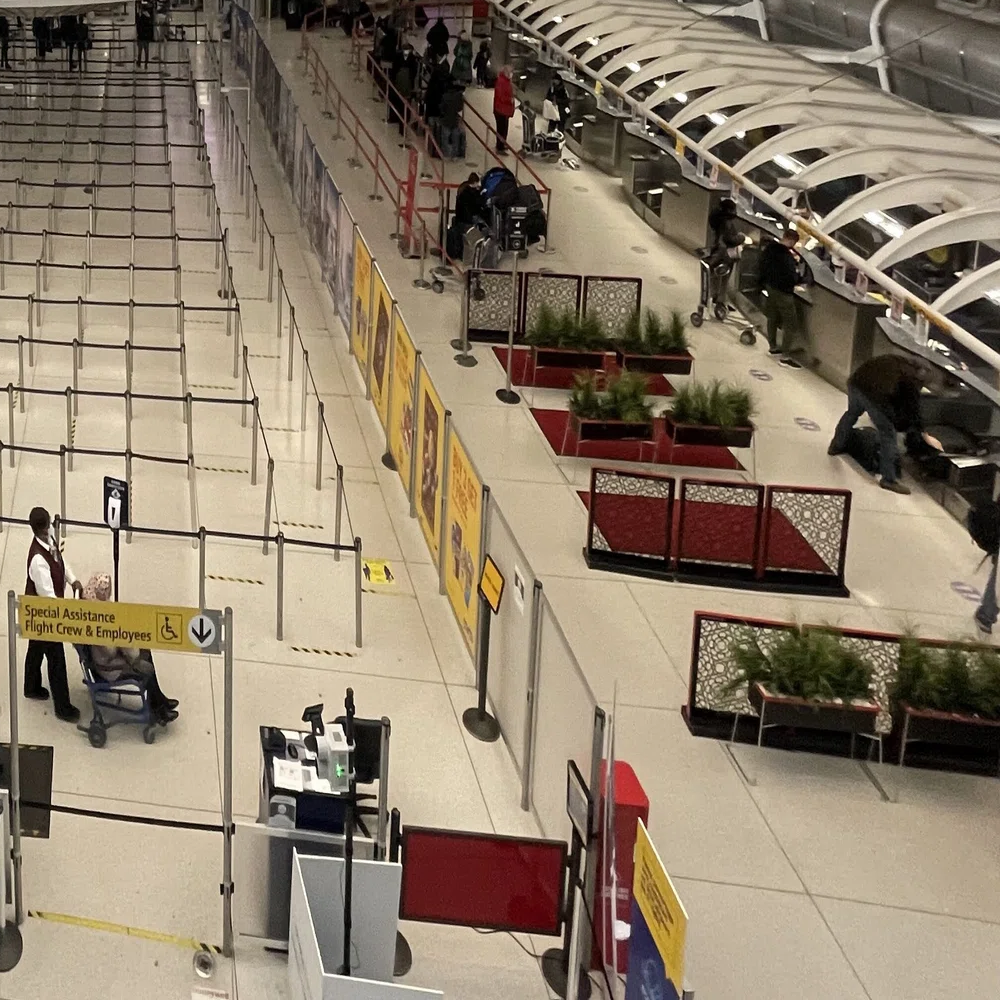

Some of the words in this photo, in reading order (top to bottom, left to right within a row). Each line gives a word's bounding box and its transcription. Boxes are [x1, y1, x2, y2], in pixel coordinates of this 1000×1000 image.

[24, 604, 60, 621] Special
[62, 608, 116, 624] Assistance
[25, 620, 54, 636] Flight
[56, 622, 83, 637] Crew
[85, 626, 94, 637] &
[96, 626, 152, 643] Employees
